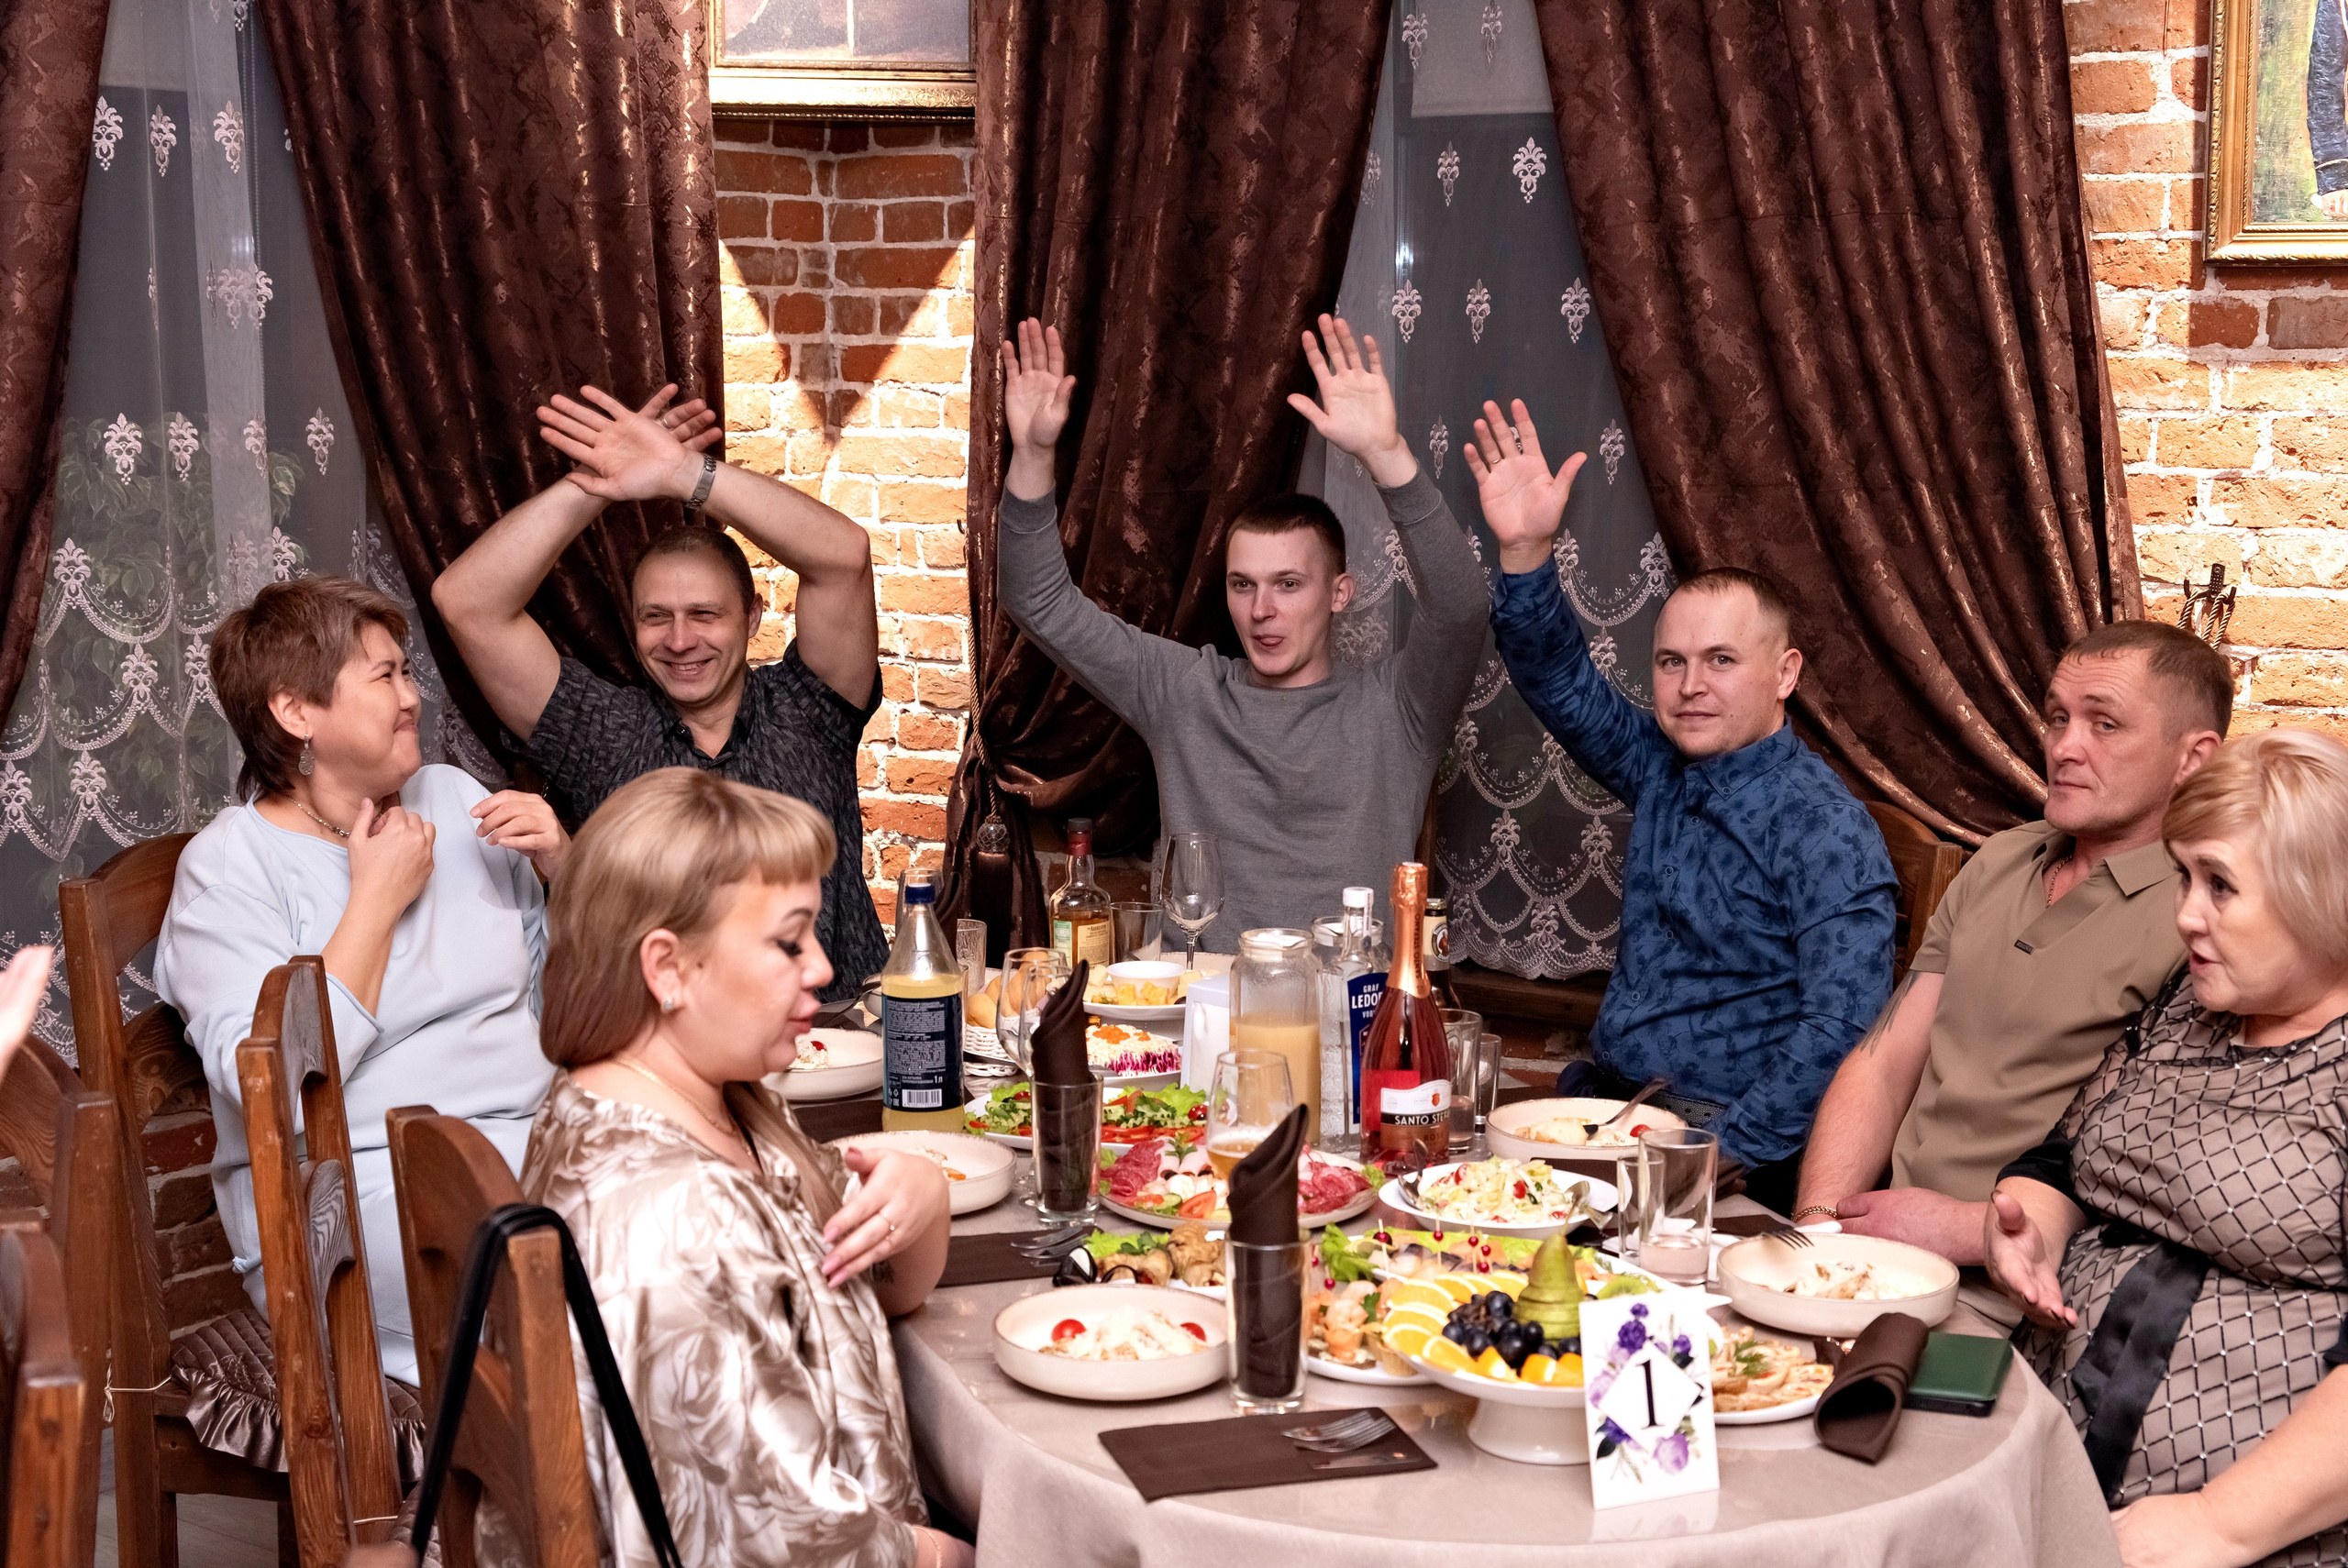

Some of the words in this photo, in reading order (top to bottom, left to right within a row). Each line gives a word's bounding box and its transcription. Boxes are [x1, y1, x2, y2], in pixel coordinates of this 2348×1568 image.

[1363, 983, 1379, 993] GRAF
[1362, 1010, 1376, 1019] VOD
[934, 1075, 937, 1084] 1
[1395, 1115, 1429, 1125] SANTO
[1635, 1359, 1665, 1430] 1
